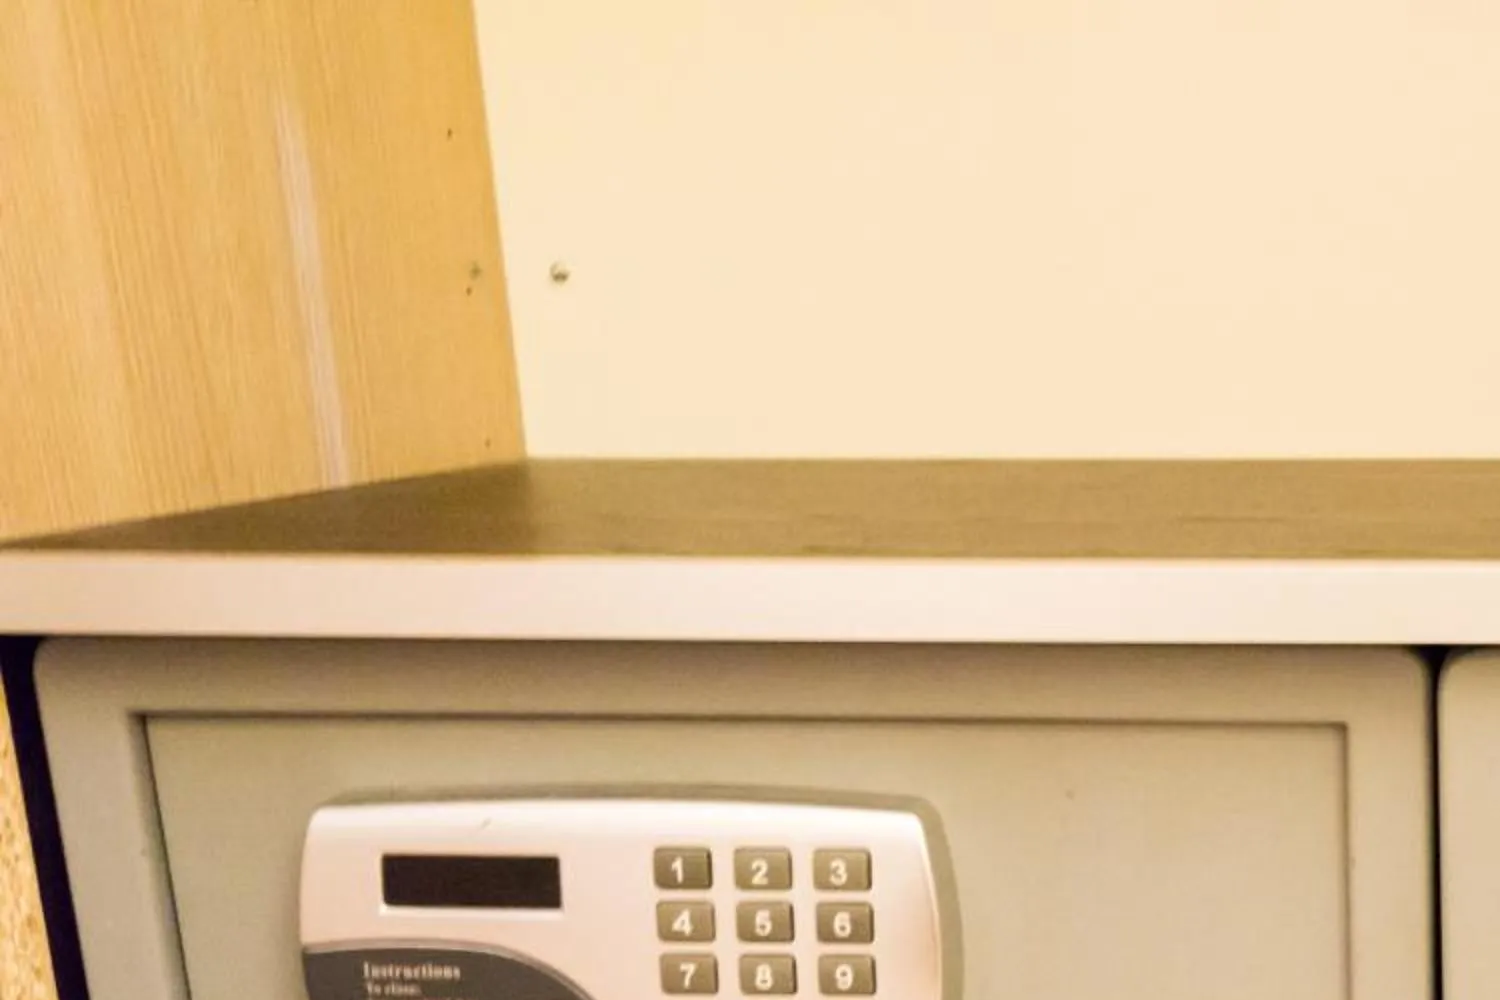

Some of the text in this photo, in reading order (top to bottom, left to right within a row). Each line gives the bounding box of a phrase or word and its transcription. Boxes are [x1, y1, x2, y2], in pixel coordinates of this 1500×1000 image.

[671, 857, 847, 886] 1 2 3
[672, 909, 851, 937] 4 5 6
[363, 961, 461, 980] Instructions
[680, 962, 853, 990] 7 8 9
